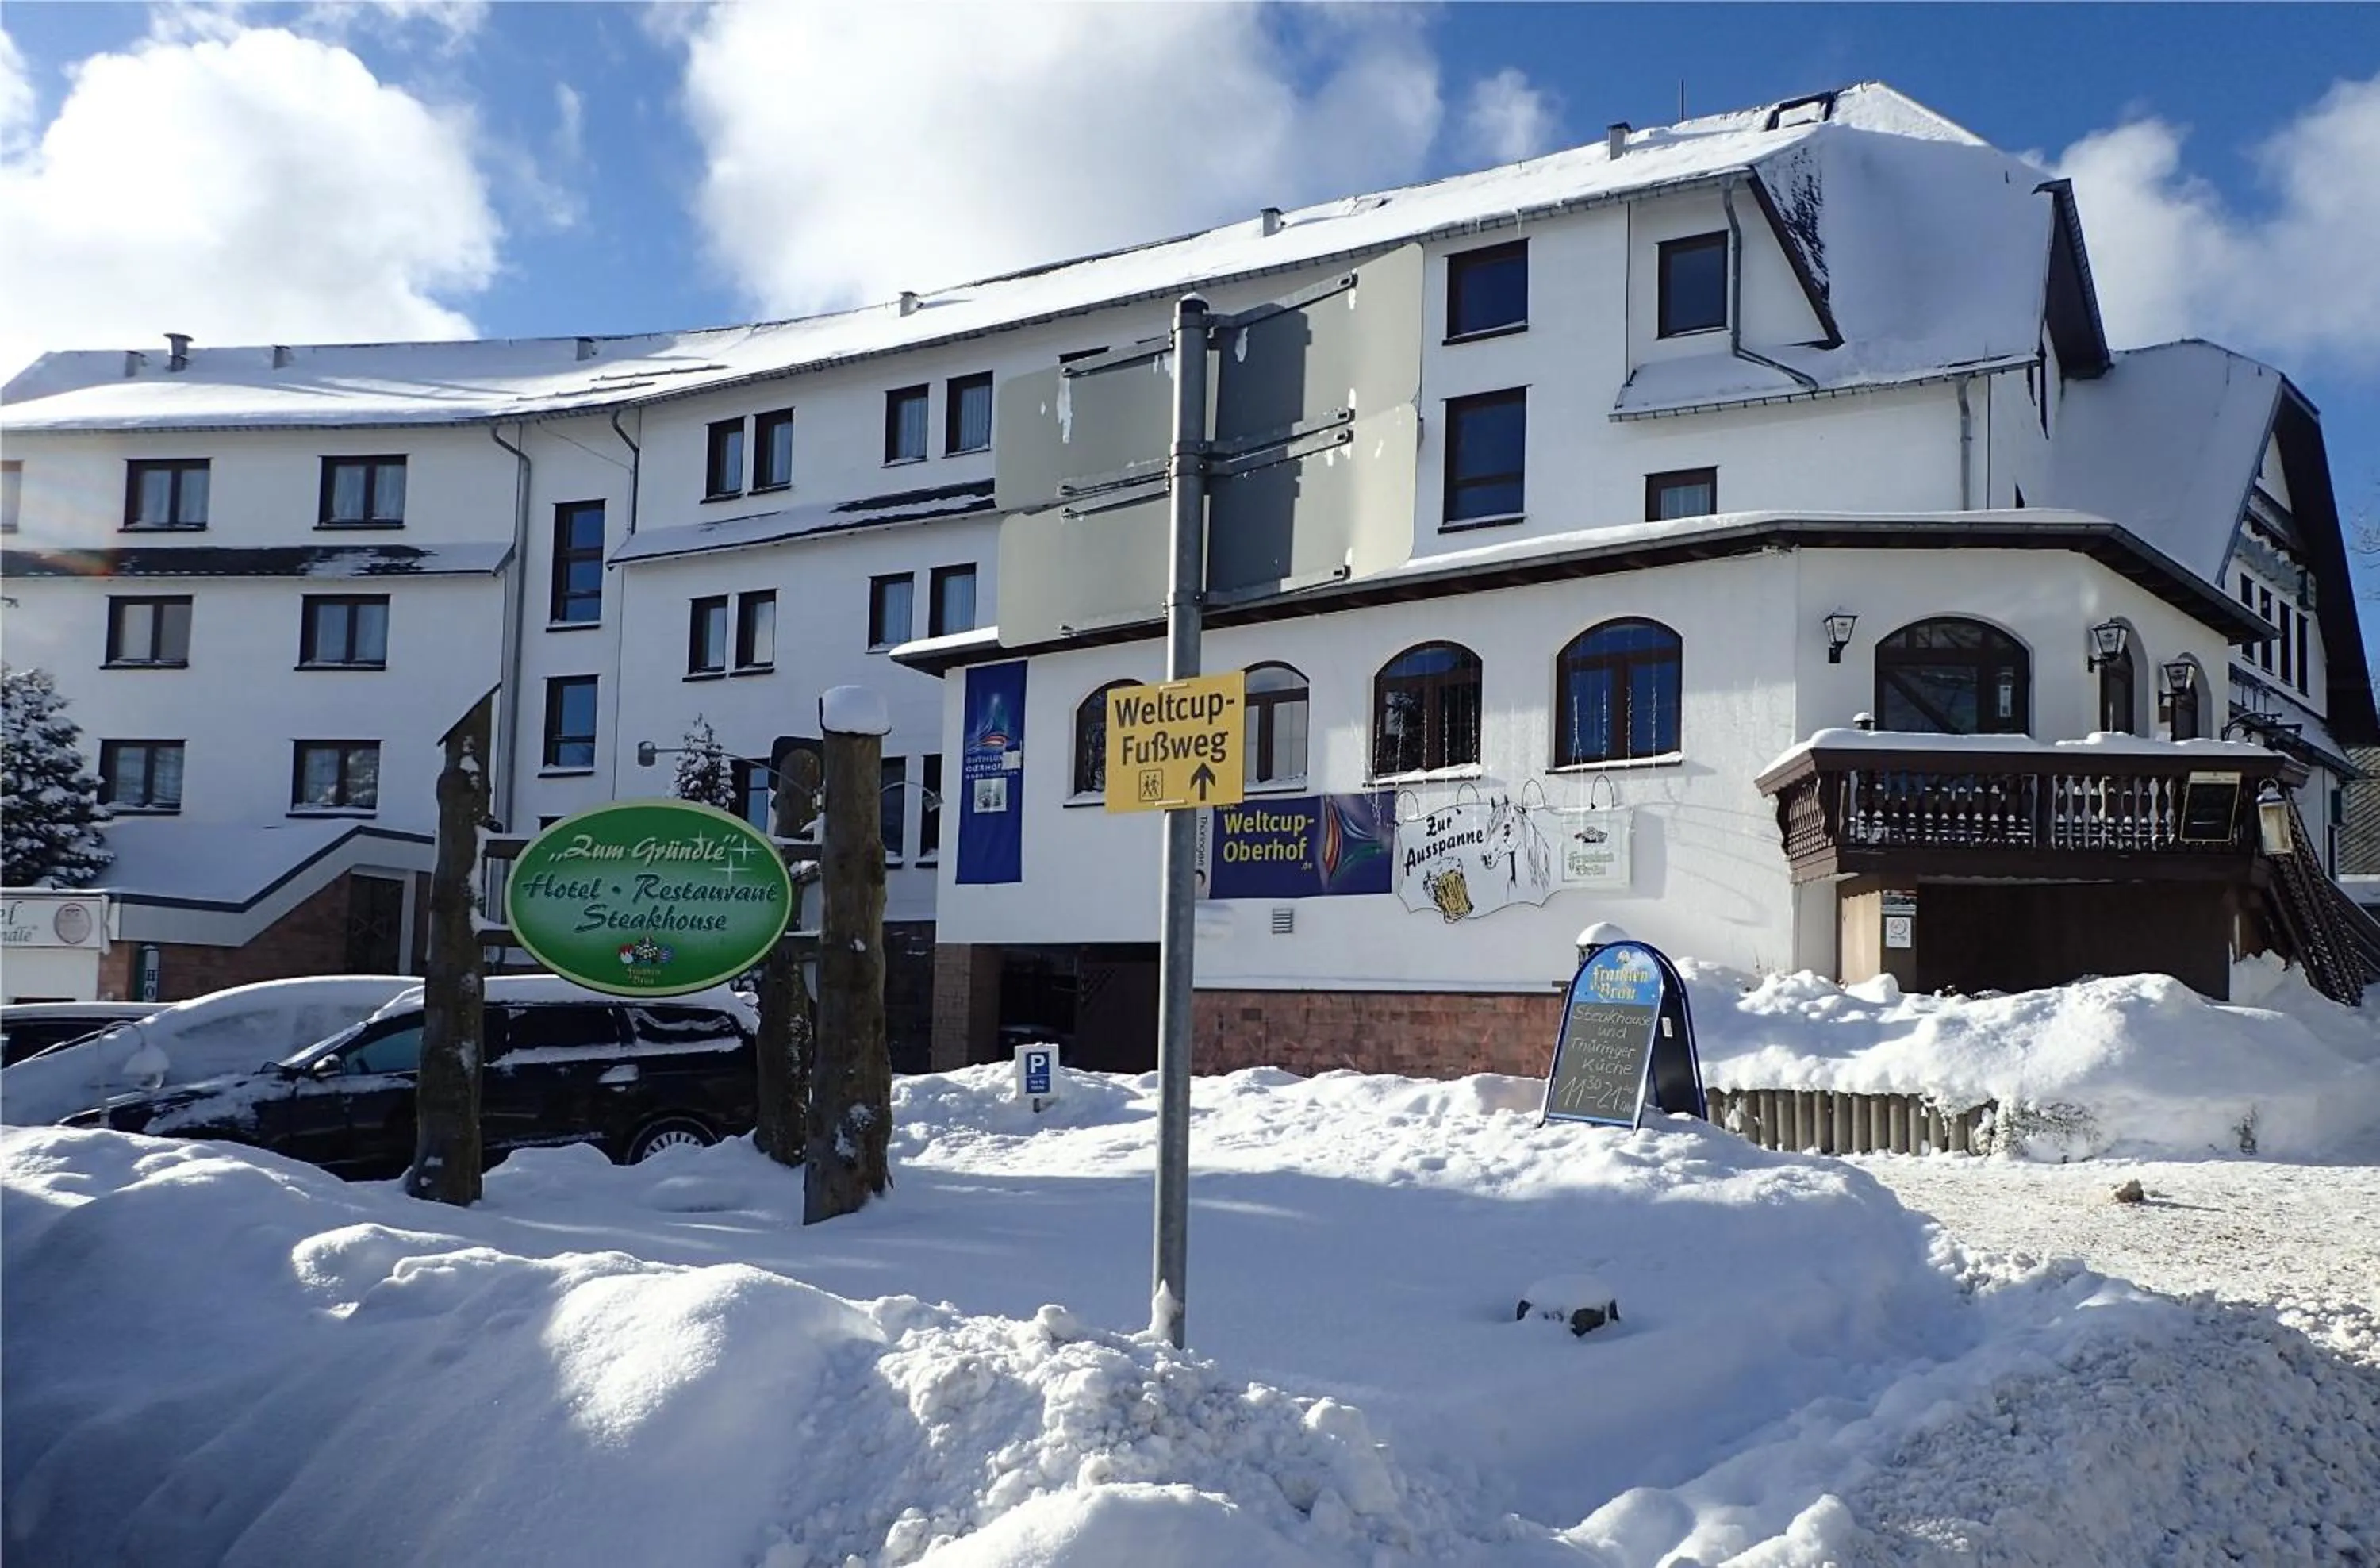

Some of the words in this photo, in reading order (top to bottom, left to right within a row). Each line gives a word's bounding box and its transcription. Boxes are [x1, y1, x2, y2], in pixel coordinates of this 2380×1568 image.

[1115, 692, 1235, 728] Weltcup-
[1122, 730, 1229, 766] Fußweg
[1223, 809, 1315, 837] Weltcup-
[1426, 816, 1453, 836] Zur
[1223, 836, 1308, 863] Oberhof
[1403, 828, 1484, 877] Ausspanne
[522, 874, 601, 901] Hotel
[633, 874, 778, 903] Restaurant
[574, 904, 727, 934] Steakhouse
[1031, 1055, 1046, 1073] P
[1582, 1058, 1633, 1075] Küche
